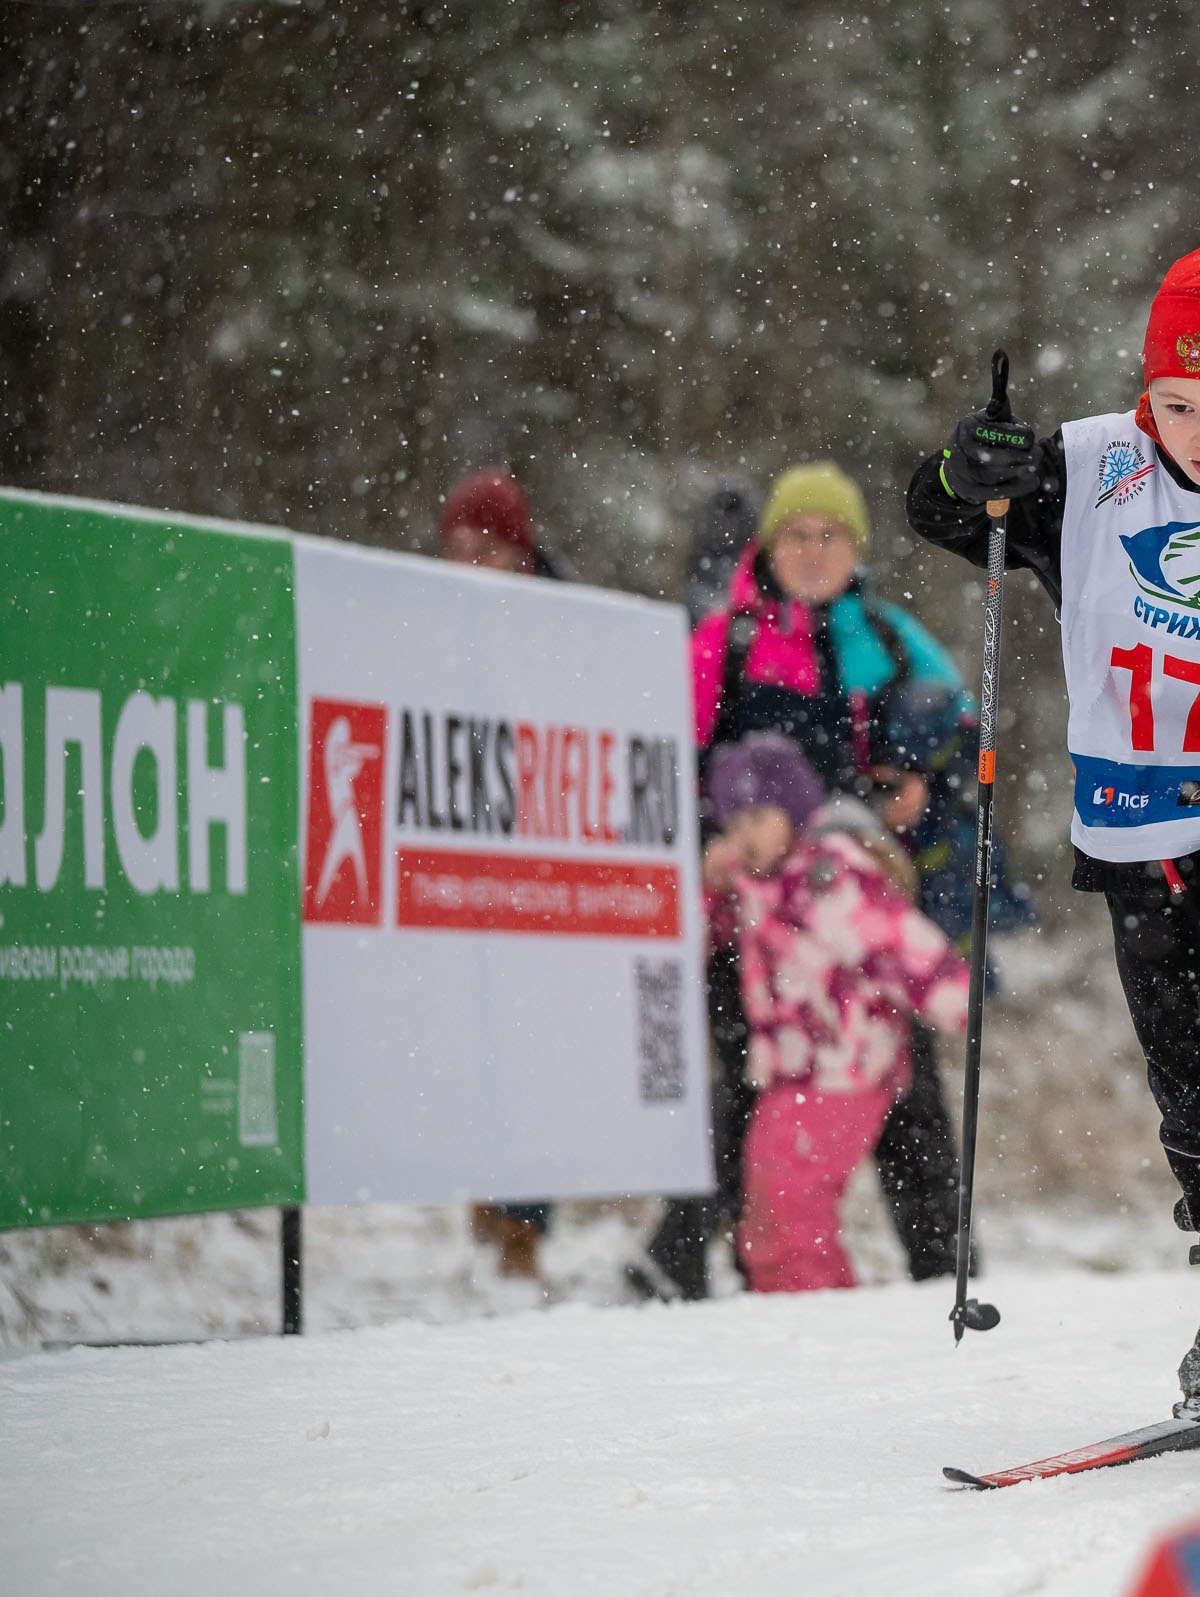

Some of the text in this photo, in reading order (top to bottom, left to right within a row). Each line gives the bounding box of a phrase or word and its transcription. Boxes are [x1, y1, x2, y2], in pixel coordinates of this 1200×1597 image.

[975, 426, 1025, 445] CAST-TEX
[399, 708, 678, 848] ALEKSRIFLE.RU
[1117, 792, 1149, 809] ПСБ
